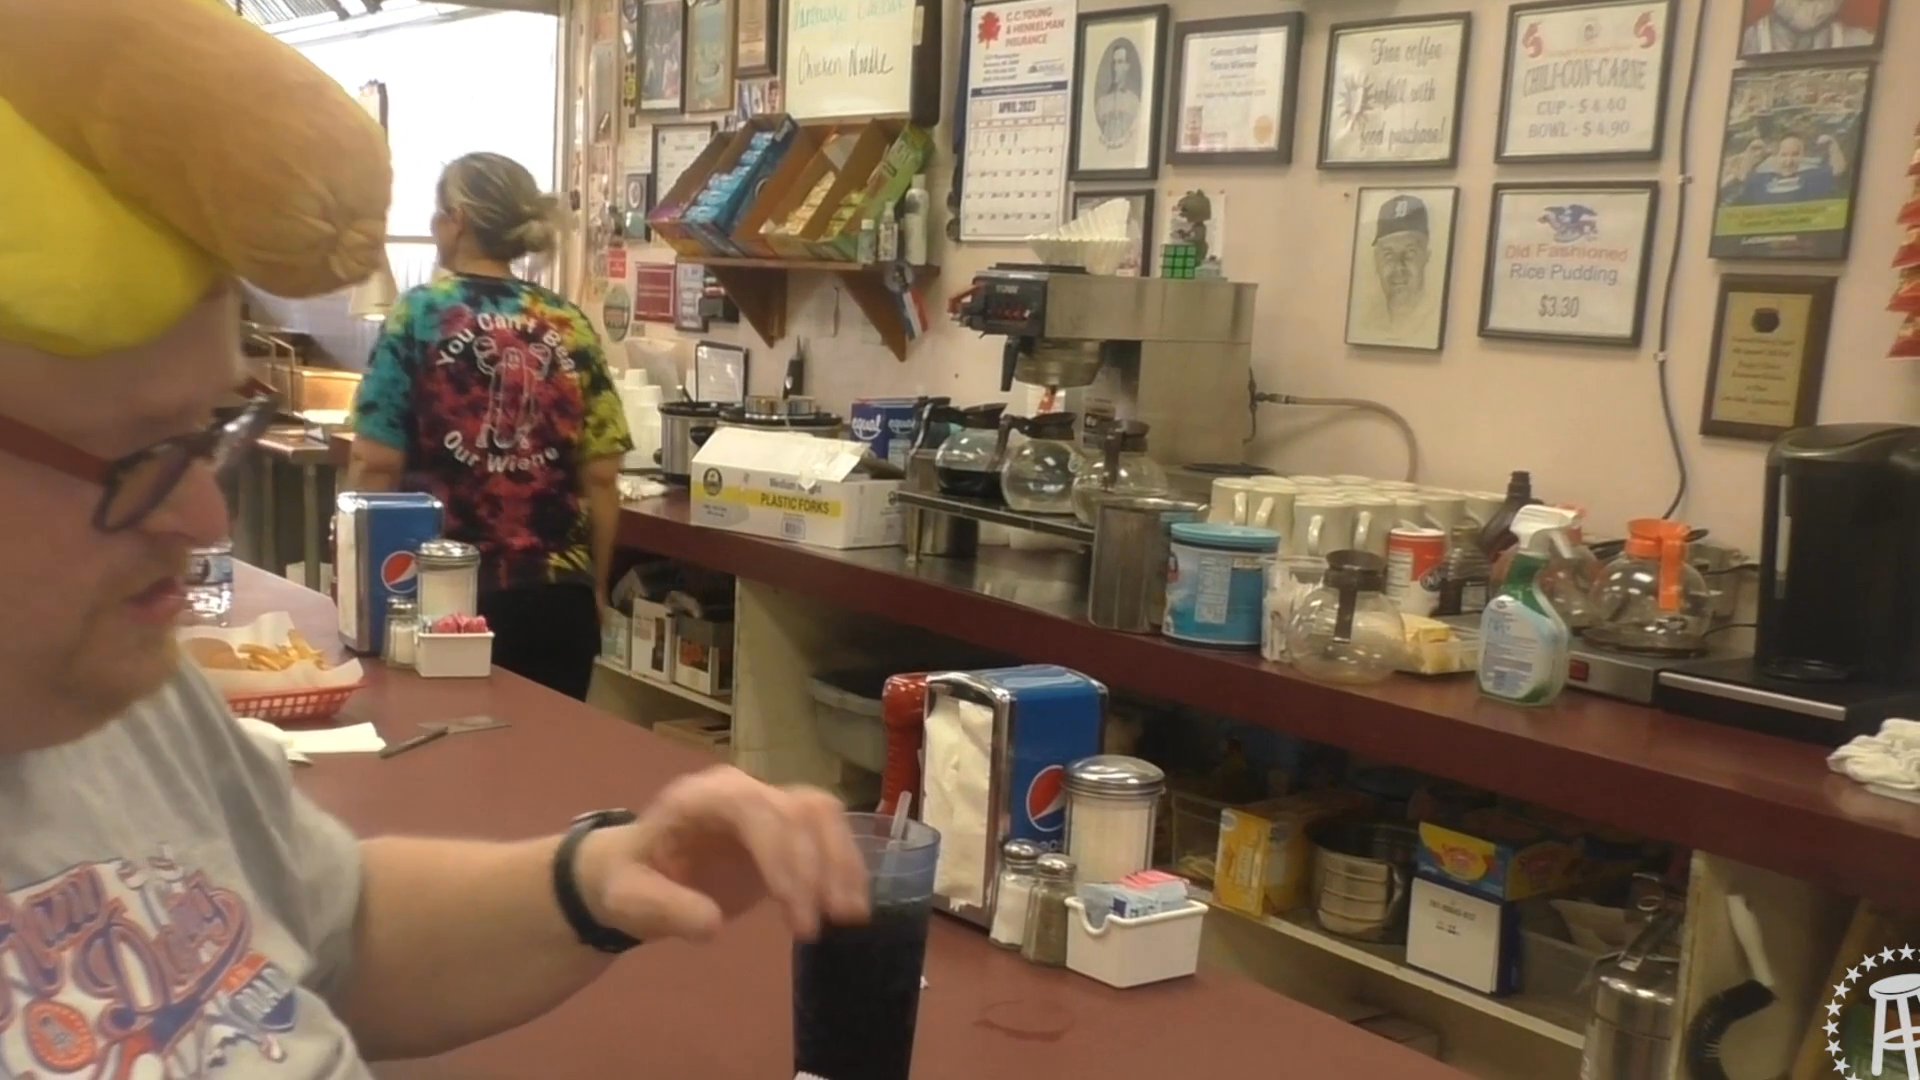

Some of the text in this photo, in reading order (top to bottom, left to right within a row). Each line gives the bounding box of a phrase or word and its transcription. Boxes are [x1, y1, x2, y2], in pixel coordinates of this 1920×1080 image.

[1005, 33, 1047, 47] INSURANCE
[798, 40, 894, 86] Chicken Noodle
[1371, 36, 1442, 68] Free coffee
[1522, 57, 1648, 97] CHILI-CON-CARNE
[998, 101, 1017, 114] APRIL
[1536, 100, 1568, 116] CUP
[1527, 121, 1569, 139] BOWL
[1505, 243, 1629, 263] Old Fashioned
[1510, 263, 1619, 286] Rice Pudding
[1538, 294, 1581, 318] $3.30
[436, 328, 475, 366] You
[852, 414, 882, 439] equal
[443, 430, 480, 467] Our
[760, 492, 830, 515] PLASTIC FORKS
